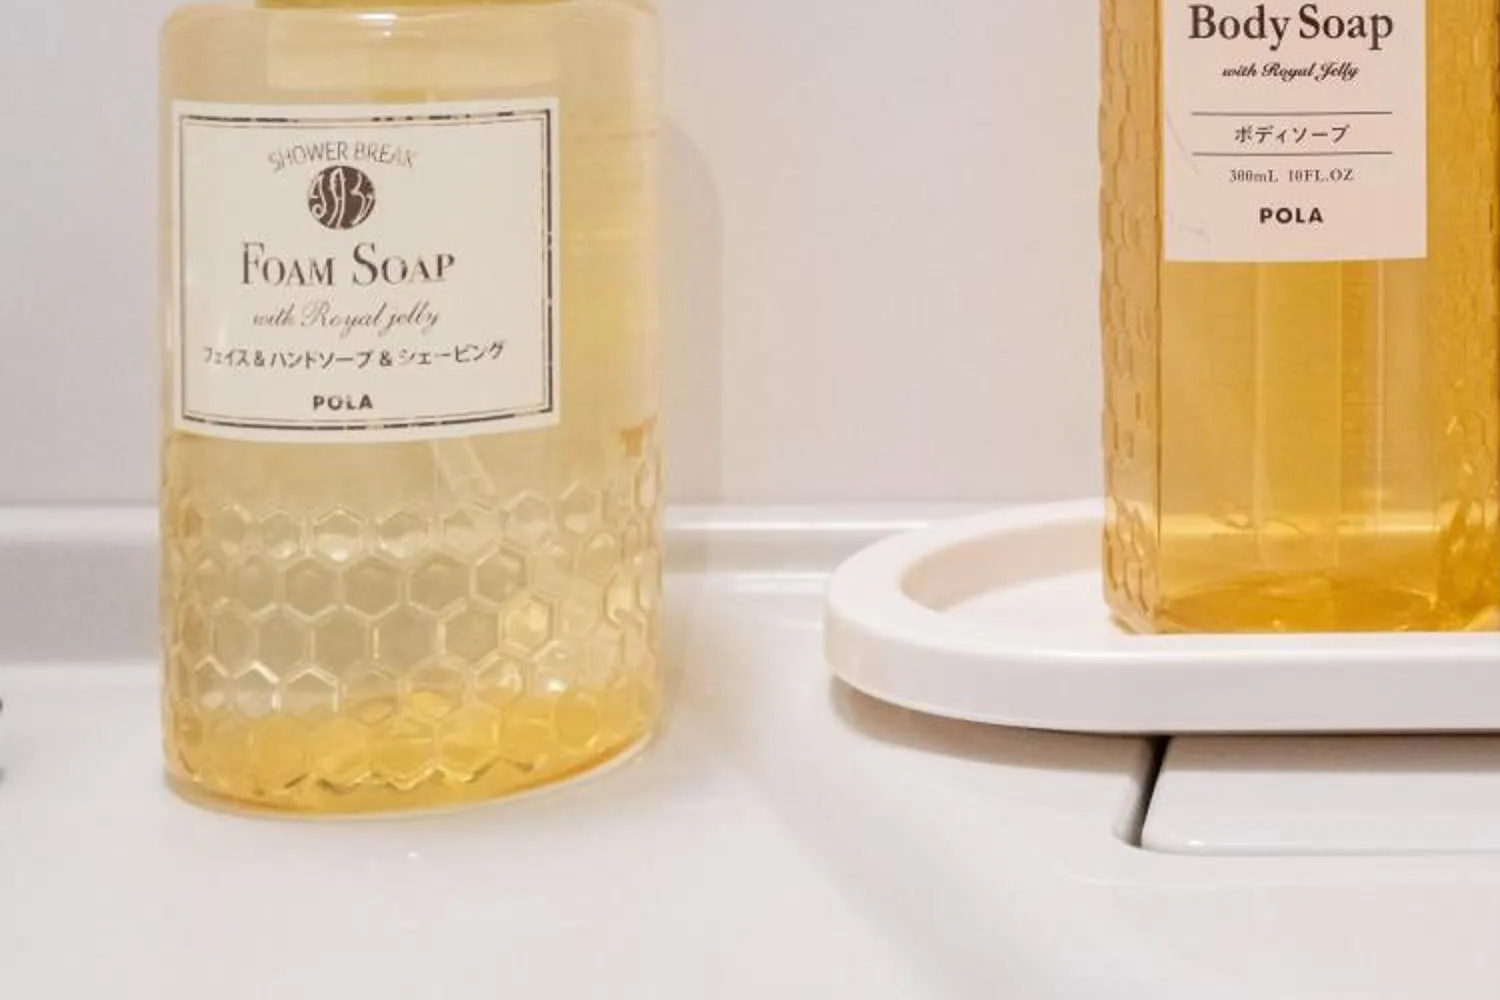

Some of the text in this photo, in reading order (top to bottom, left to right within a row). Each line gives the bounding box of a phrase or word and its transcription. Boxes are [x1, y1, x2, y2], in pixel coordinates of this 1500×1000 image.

[1188, 4, 1394, 51] Body Soap
[1222, 62, 1358, 82] with Royal Jelly
[1234, 124, 1349, 143] ボディソープ
[268, 141, 416, 172] SHOWER BREAK
[1229, 169, 1278, 183] 300mL
[1259, 207, 1323, 224] POLA
[241, 242, 455, 287] FOAM SOAP
[253, 305, 295, 328] with
[300, 301, 382, 338] Royal
[313, 395, 373, 410] POLA
